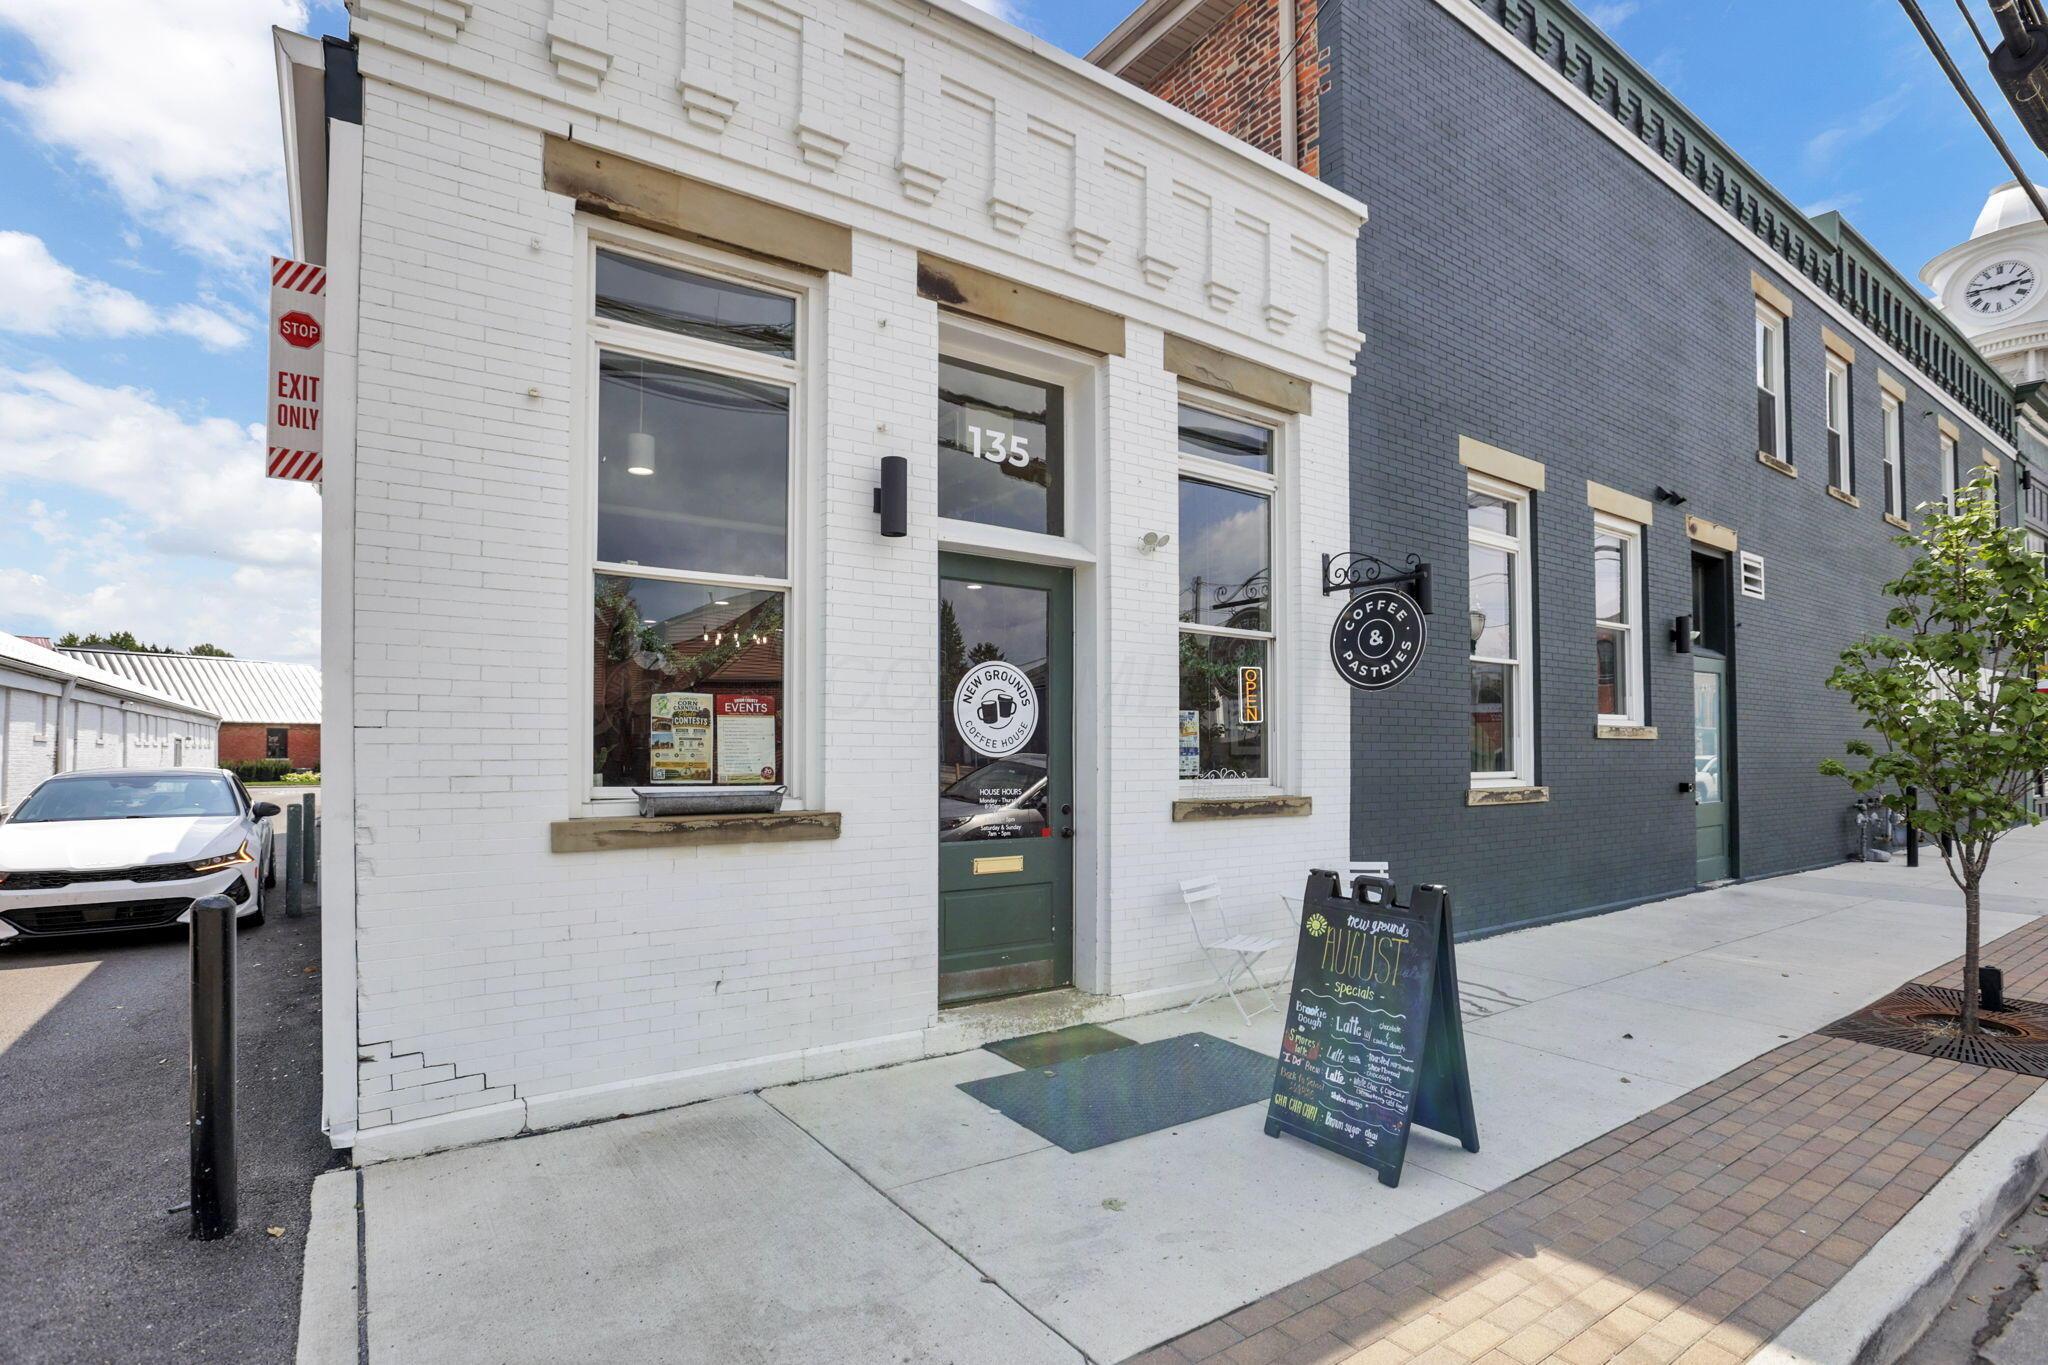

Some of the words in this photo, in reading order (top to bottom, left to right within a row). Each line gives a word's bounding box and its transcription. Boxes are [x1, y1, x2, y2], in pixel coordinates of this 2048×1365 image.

[283, 321, 318, 338] STOP
[278, 371, 320, 402] EXIT
[278, 404, 319, 430] ONLY
[968, 425, 1030, 468] 135
[1344, 600, 1408, 631] COFFEE
[1370, 630, 1383, 645] &
[1343, 640, 1412, 678] PASTRIES
[963, 675, 983, 704] NEW
[984, 670, 1031, 707] GROUNDS
[1245, 669, 1258, 722] OPEN
[724, 703, 768, 713] EVENTS
[674, 716, 708, 726] CONTESTS
[965, 720, 997, 748] COFFEE
[1001, 721, 1028, 748] HOUSE
[979, 788, 1000, 796] HOUSE
[1001, 788, 1022, 796] HOURS
[1347, 914, 1370, 931] new
[1371, 920, 1410, 938] grounds
[1321, 927, 1410, 986] AUGUST
[1334, 981, 1375, 1000] specials
[1297, 1013, 1322, 1030] Dough
[1335, 1016, 1362, 1037] Latte
[1325, 1066, 1346, 1085] Latte
